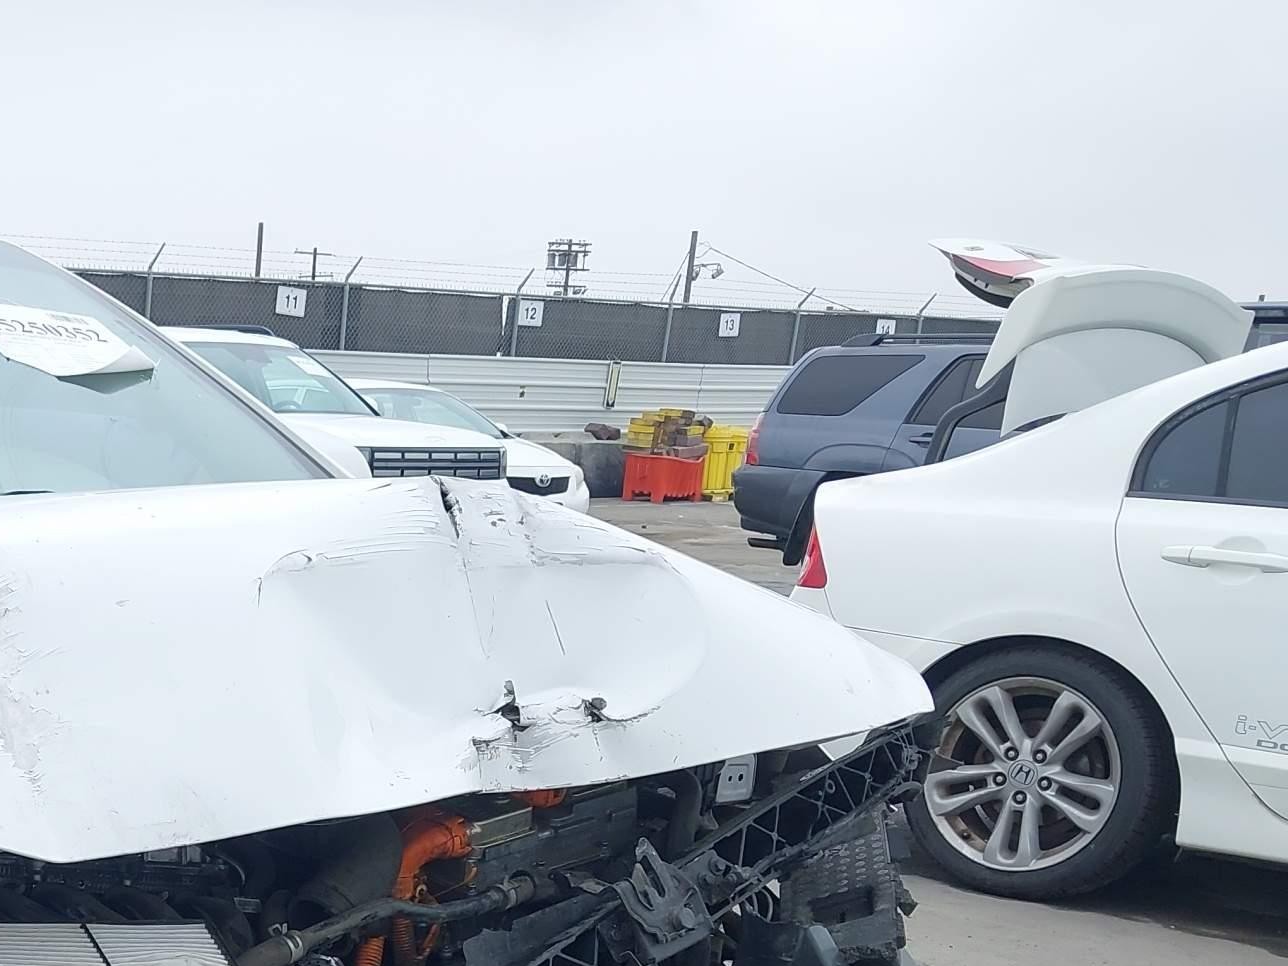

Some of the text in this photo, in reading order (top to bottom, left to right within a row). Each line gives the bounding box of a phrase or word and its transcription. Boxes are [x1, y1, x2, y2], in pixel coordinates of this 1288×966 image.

[286, 294, 298, 309] 11
[525, 307, 537, 320] 12
[725, 319, 735, 331] 13
